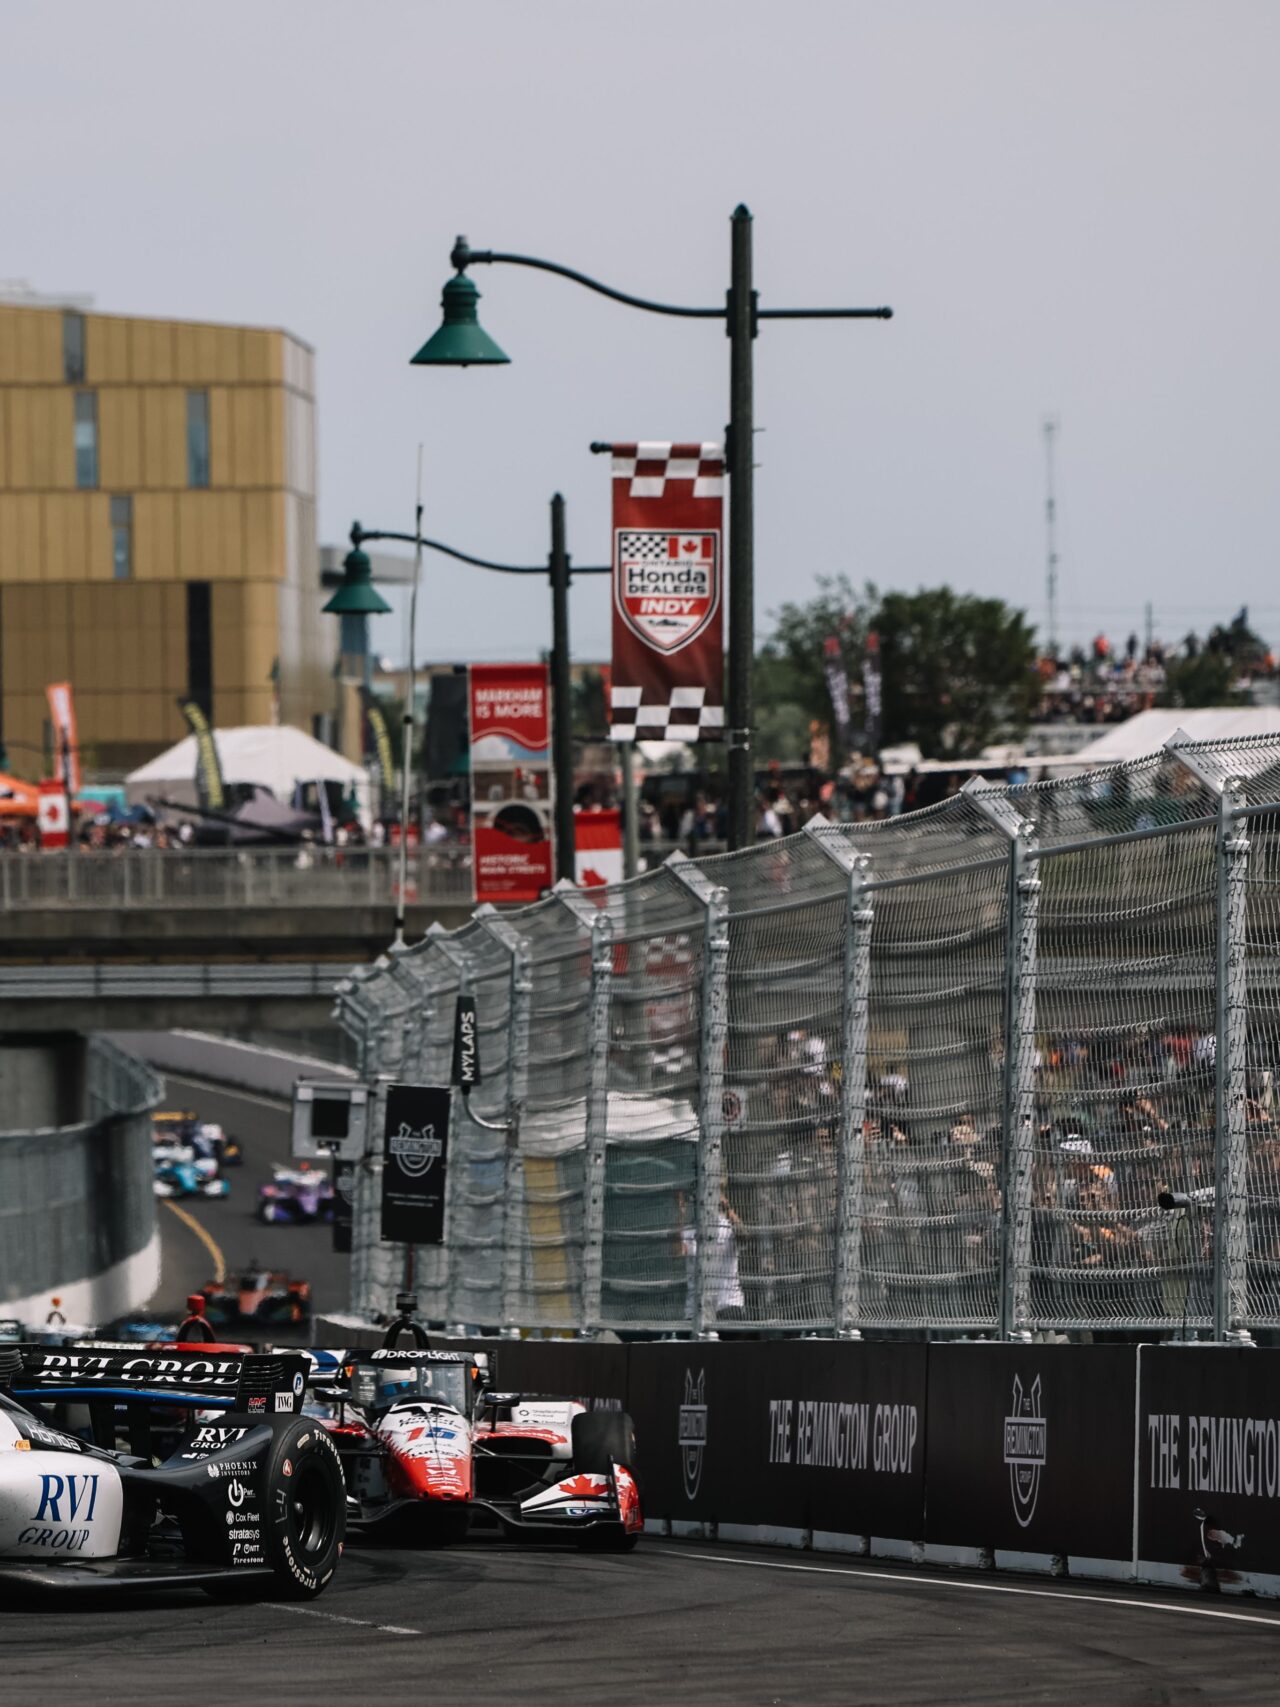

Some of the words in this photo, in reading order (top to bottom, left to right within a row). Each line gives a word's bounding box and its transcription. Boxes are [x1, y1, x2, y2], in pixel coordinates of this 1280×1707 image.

[628, 567, 707, 584] Honda
[628, 585, 707, 594] DEALERS
[639, 599, 695, 614] INDY
[475, 703, 491, 719] IS
[494, 703, 543, 719] MORE
[461, 1011, 474, 1082] MYLAPS
[387, 1350, 461, 1361] DROPLIGHT
[33, 1354, 114, 1379] RVI
[119, 1358, 243, 1385] GROU
[277, 1395, 292, 1409] TWG
[25, 1423, 81, 1452] Honda
[194, 1427, 249, 1443] RVI
[769, 1400, 793, 1463] THE
[796, 1401, 870, 1470] REMINGTON
[873, 1403, 918, 1474] GROUP
[313, 1429, 346, 1486] Firestone
[1147, 1414, 1180, 1489] THE
[220, 1461, 258, 1471] PHOENIX
[30, 1474, 99, 1523] RVI
[235, 1513, 246, 1522] Cox
[247, 1512, 260, 1522] Fleet
[18, 1527, 90, 1551] GROUP
[228, 1529, 260, 1541] stratasys
[233, 1556, 264, 1564] Firestone
[282, 1535, 317, 1589] Firestone
